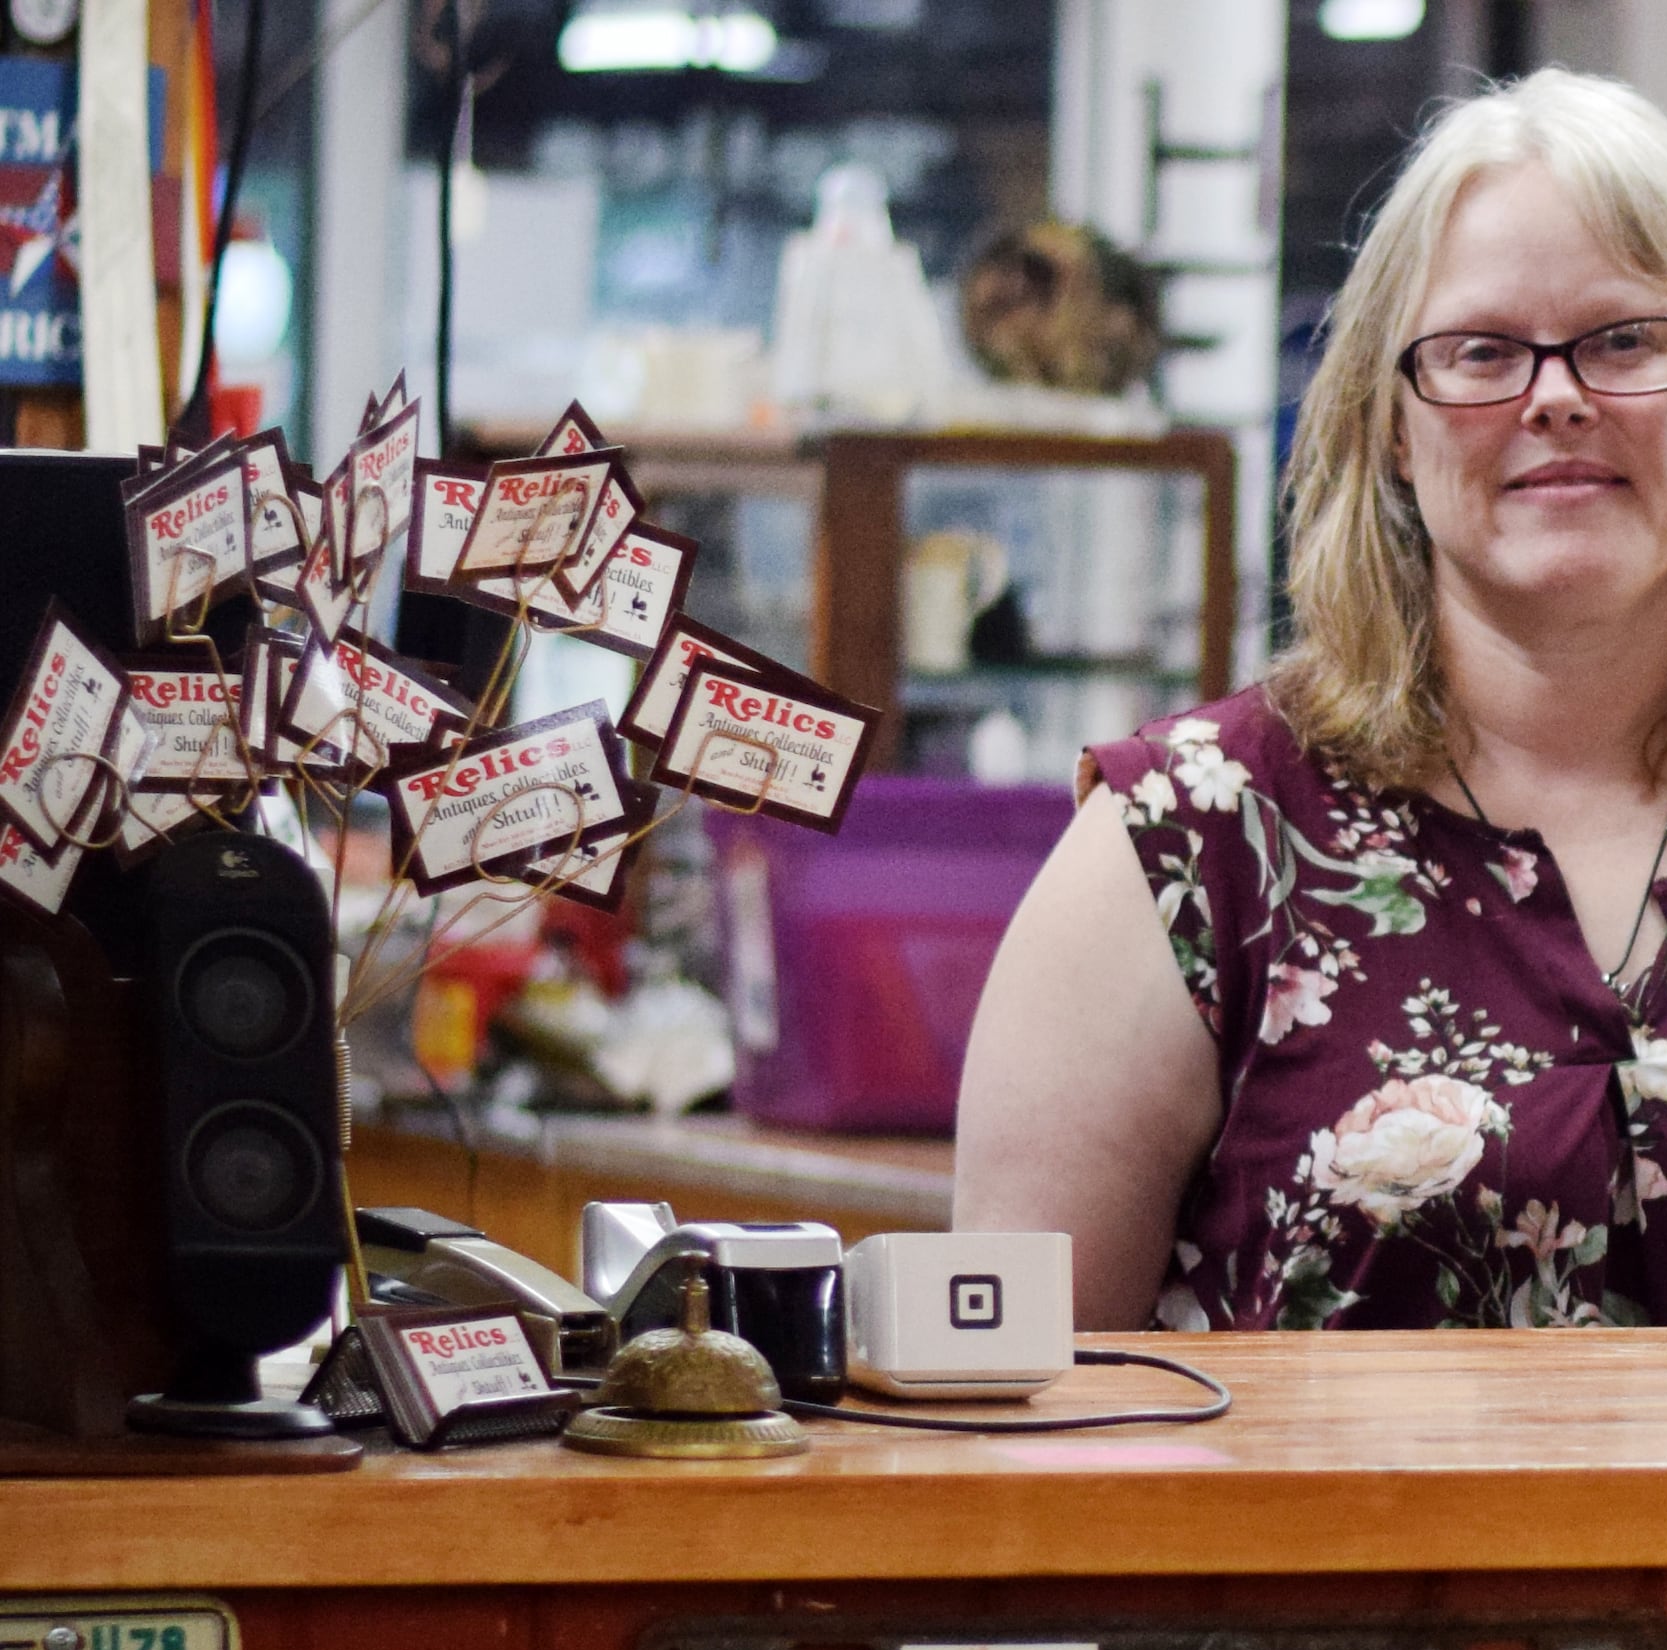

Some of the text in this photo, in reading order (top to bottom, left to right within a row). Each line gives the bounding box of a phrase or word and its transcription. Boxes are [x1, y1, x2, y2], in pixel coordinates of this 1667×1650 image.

[152, 486, 229, 540] Relics
[0, 652, 67, 786] Relics
[705, 679, 836, 740] Relics
[408, 738, 572, 801] Relics
[409, 1326, 507, 1359] Relics
